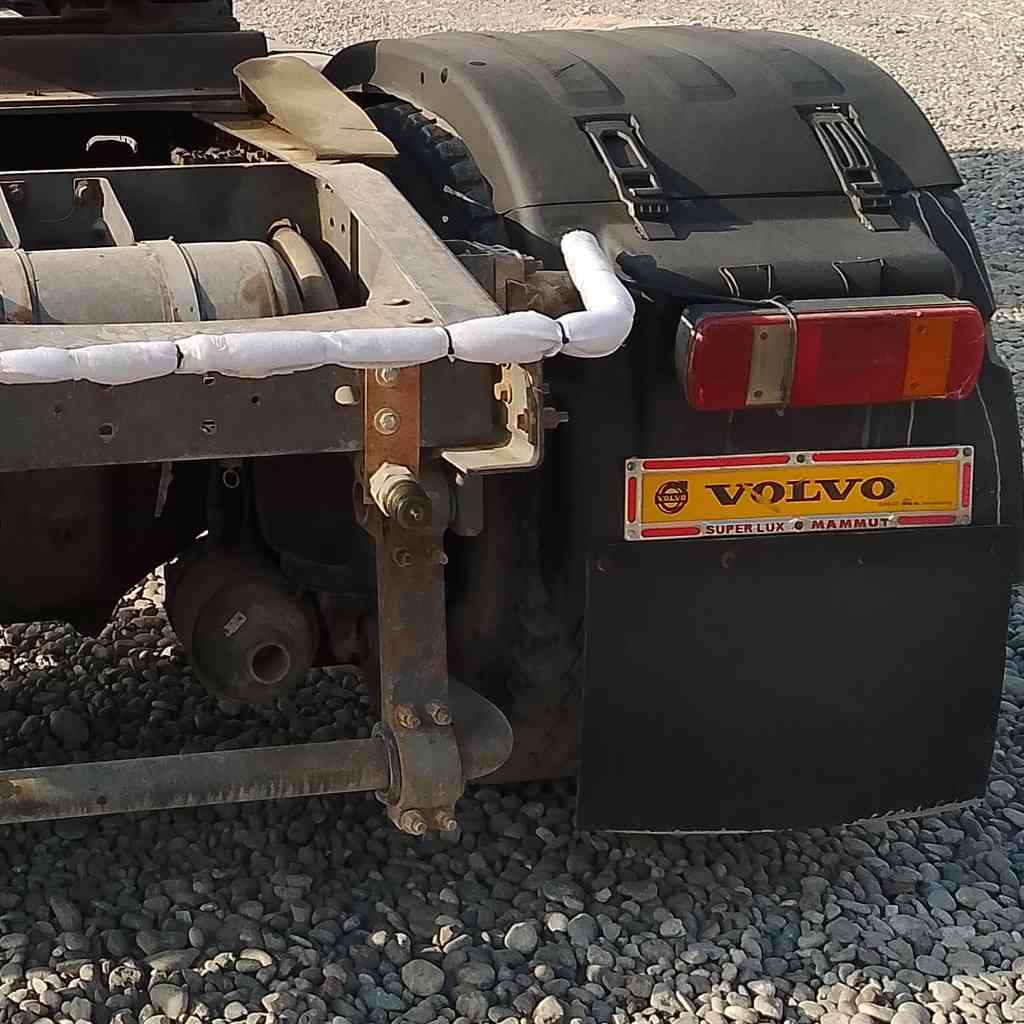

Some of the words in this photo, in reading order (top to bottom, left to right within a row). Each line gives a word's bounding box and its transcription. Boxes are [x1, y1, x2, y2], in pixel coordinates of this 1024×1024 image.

[704, 476, 897, 507] VOLVO
[706, 523, 753, 536] SUPER
[756, 522, 785, 534] LUX
[811, 517, 890, 531] MAMMUT
